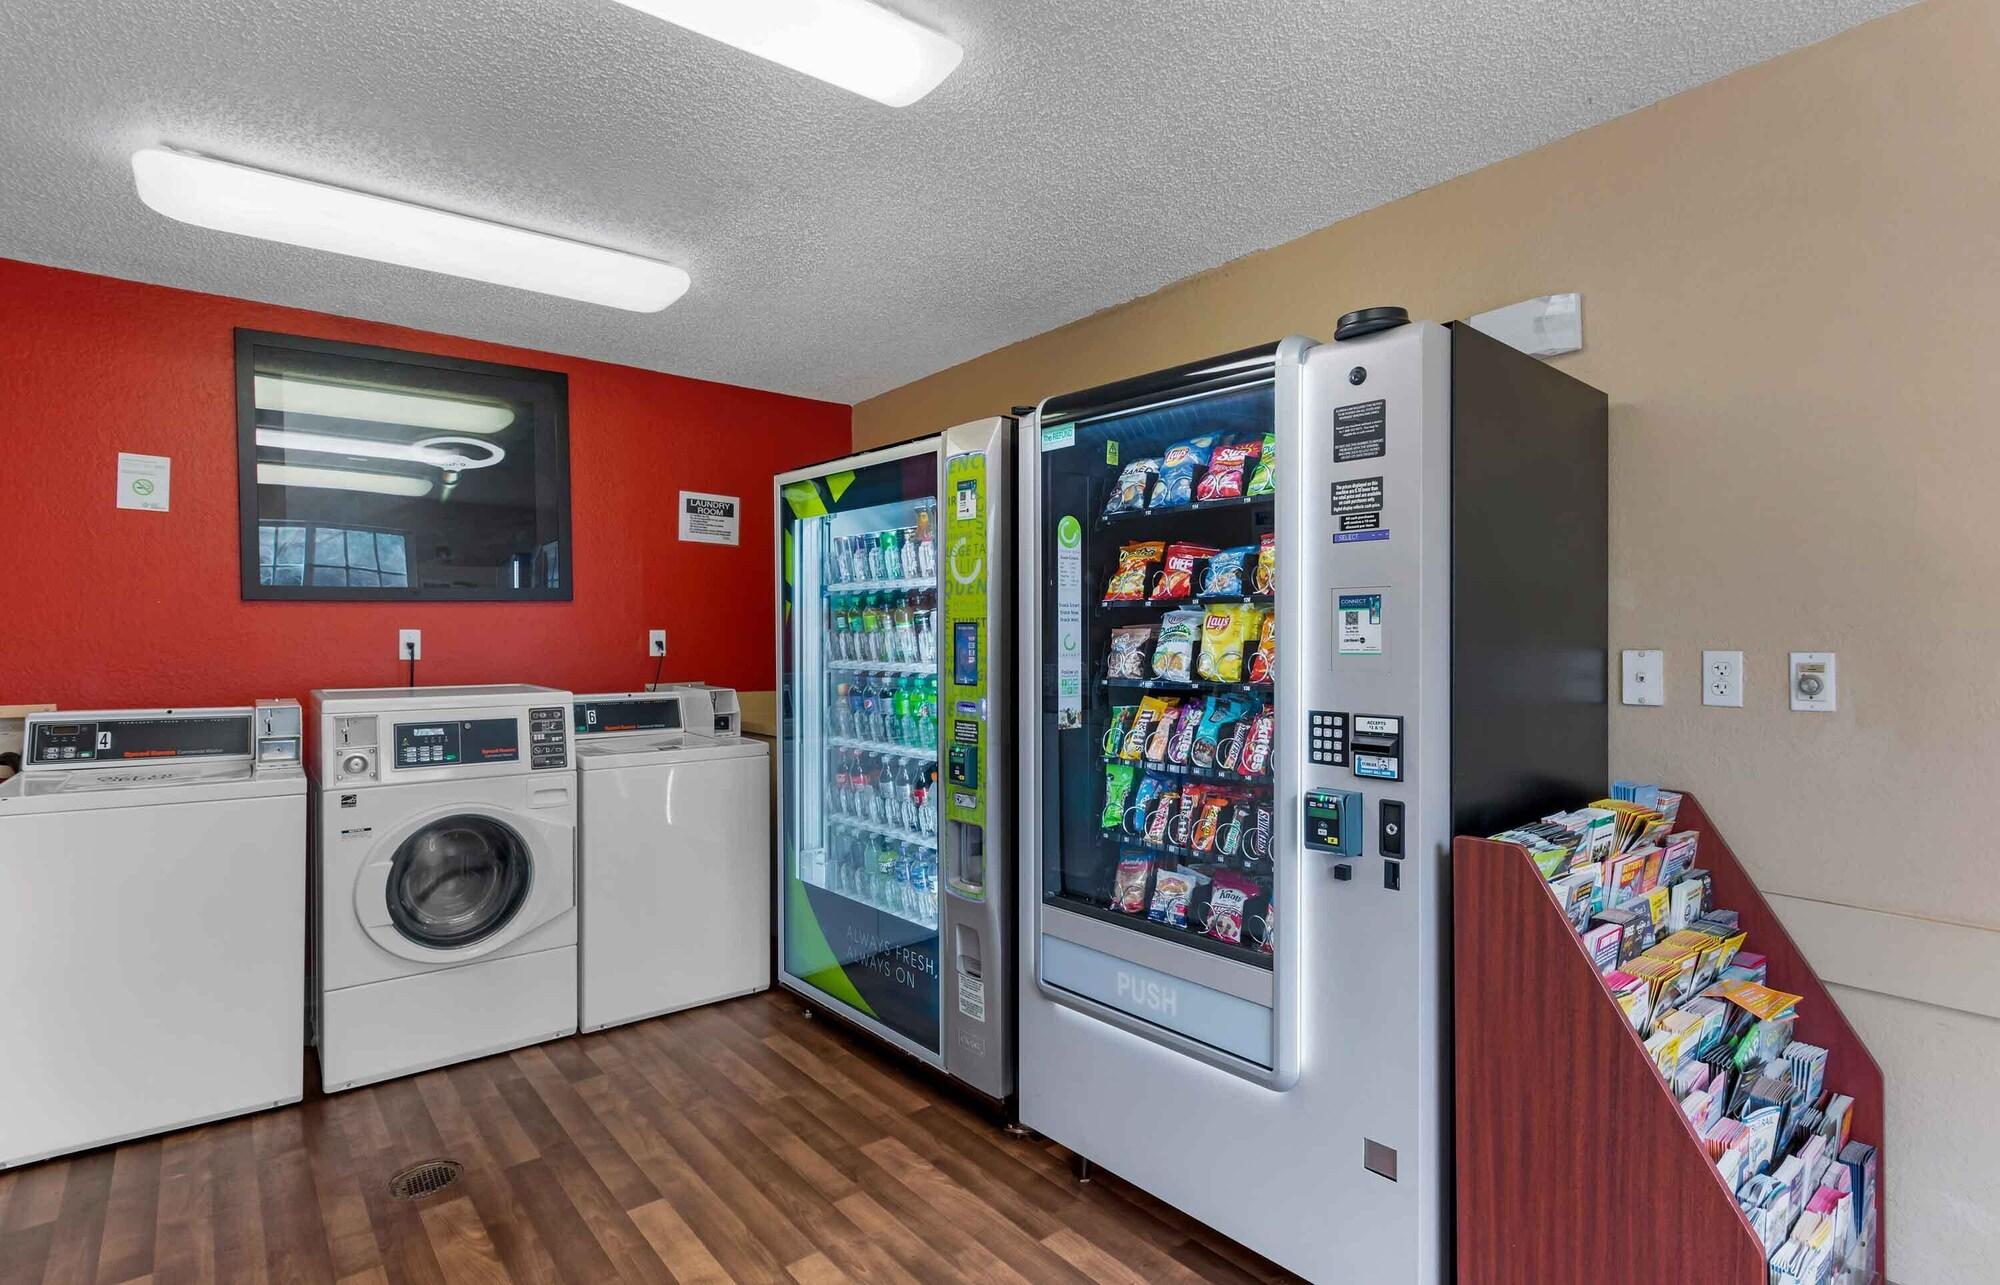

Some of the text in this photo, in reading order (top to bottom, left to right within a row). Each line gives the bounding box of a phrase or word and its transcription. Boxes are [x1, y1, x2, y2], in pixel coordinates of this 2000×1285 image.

[690, 498, 730, 509] LAUNDRY
[697, 507, 724, 516] ROOM
[588, 711, 595, 723] 6
[99, 732, 109, 749] 4
[847, 925, 938, 979] ALWAYS FRESH,
[847, 945, 915, 988] ALWAYS ON
[1117, 971, 1177, 1017] PUSH
